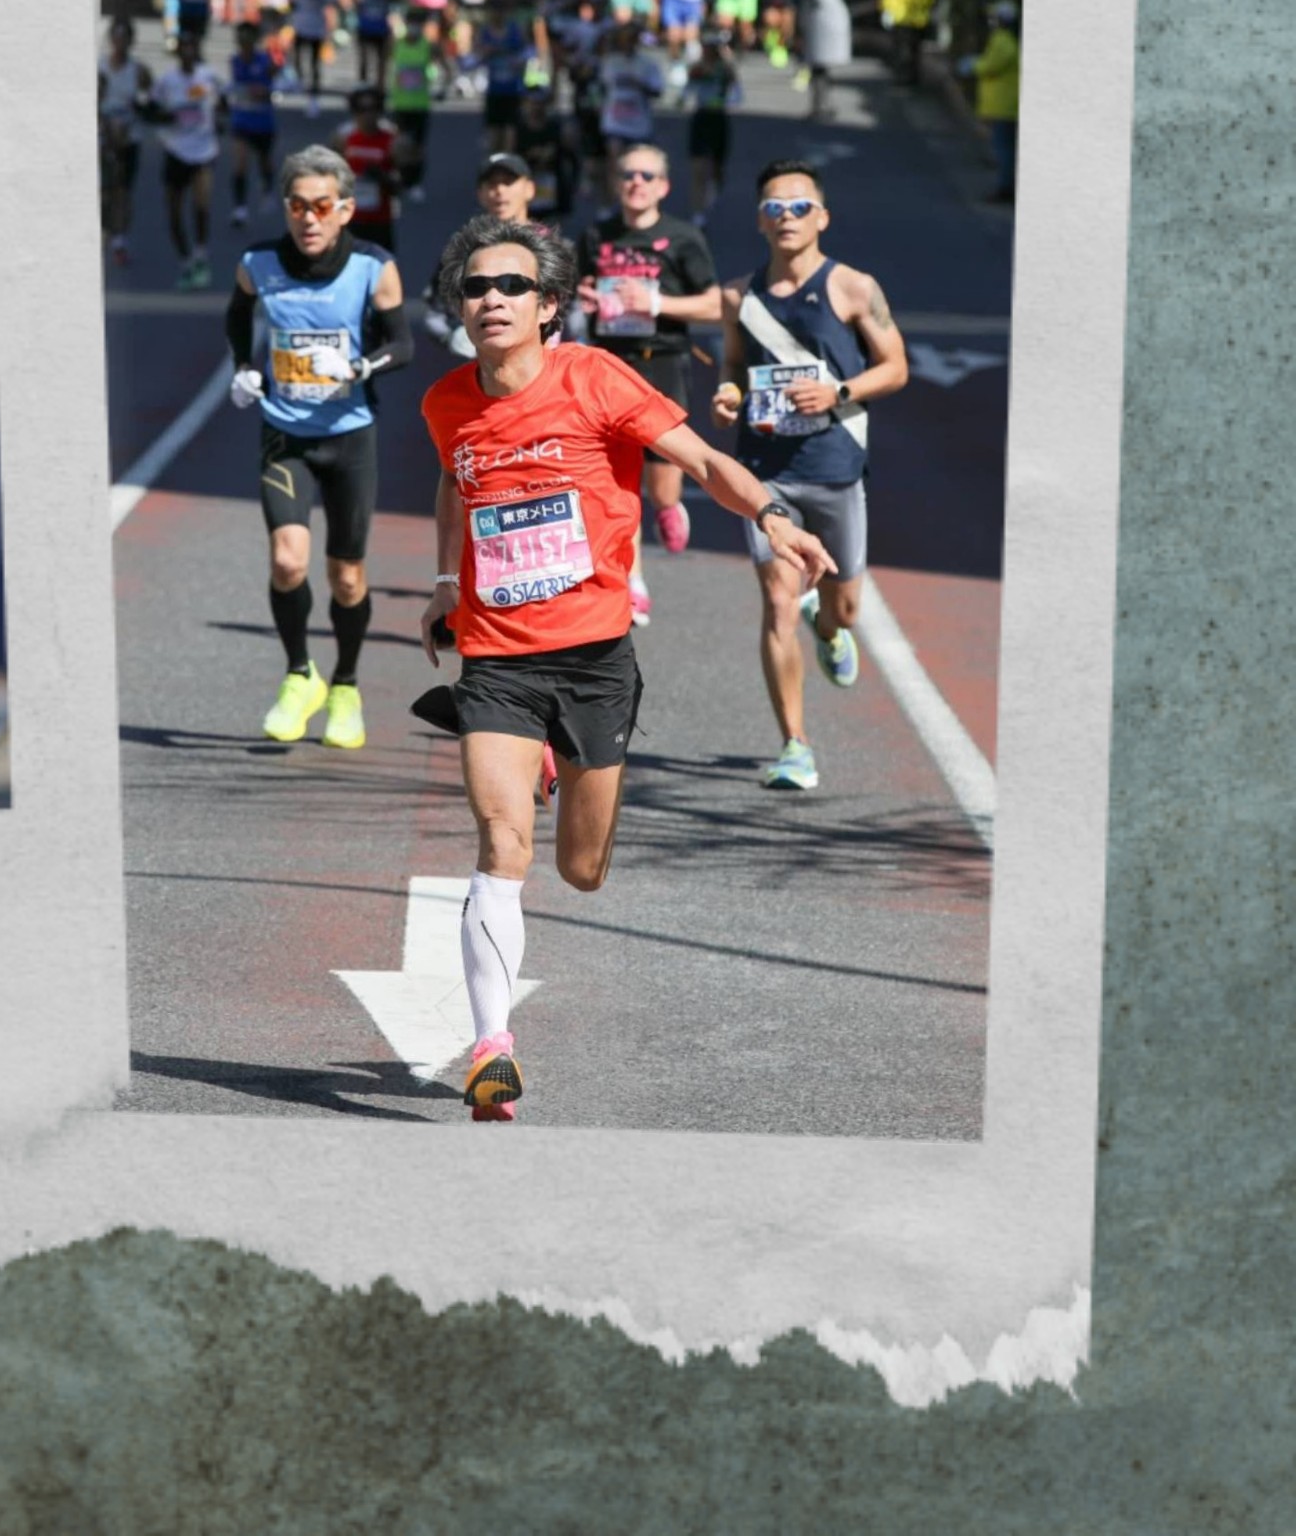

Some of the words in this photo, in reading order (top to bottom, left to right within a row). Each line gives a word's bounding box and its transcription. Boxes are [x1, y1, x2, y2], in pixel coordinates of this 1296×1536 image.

[479, 438, 564, 470] LONG
[501, 501, 566, 525] 東京メトロ
[496, 528, 569, 572] 74157
